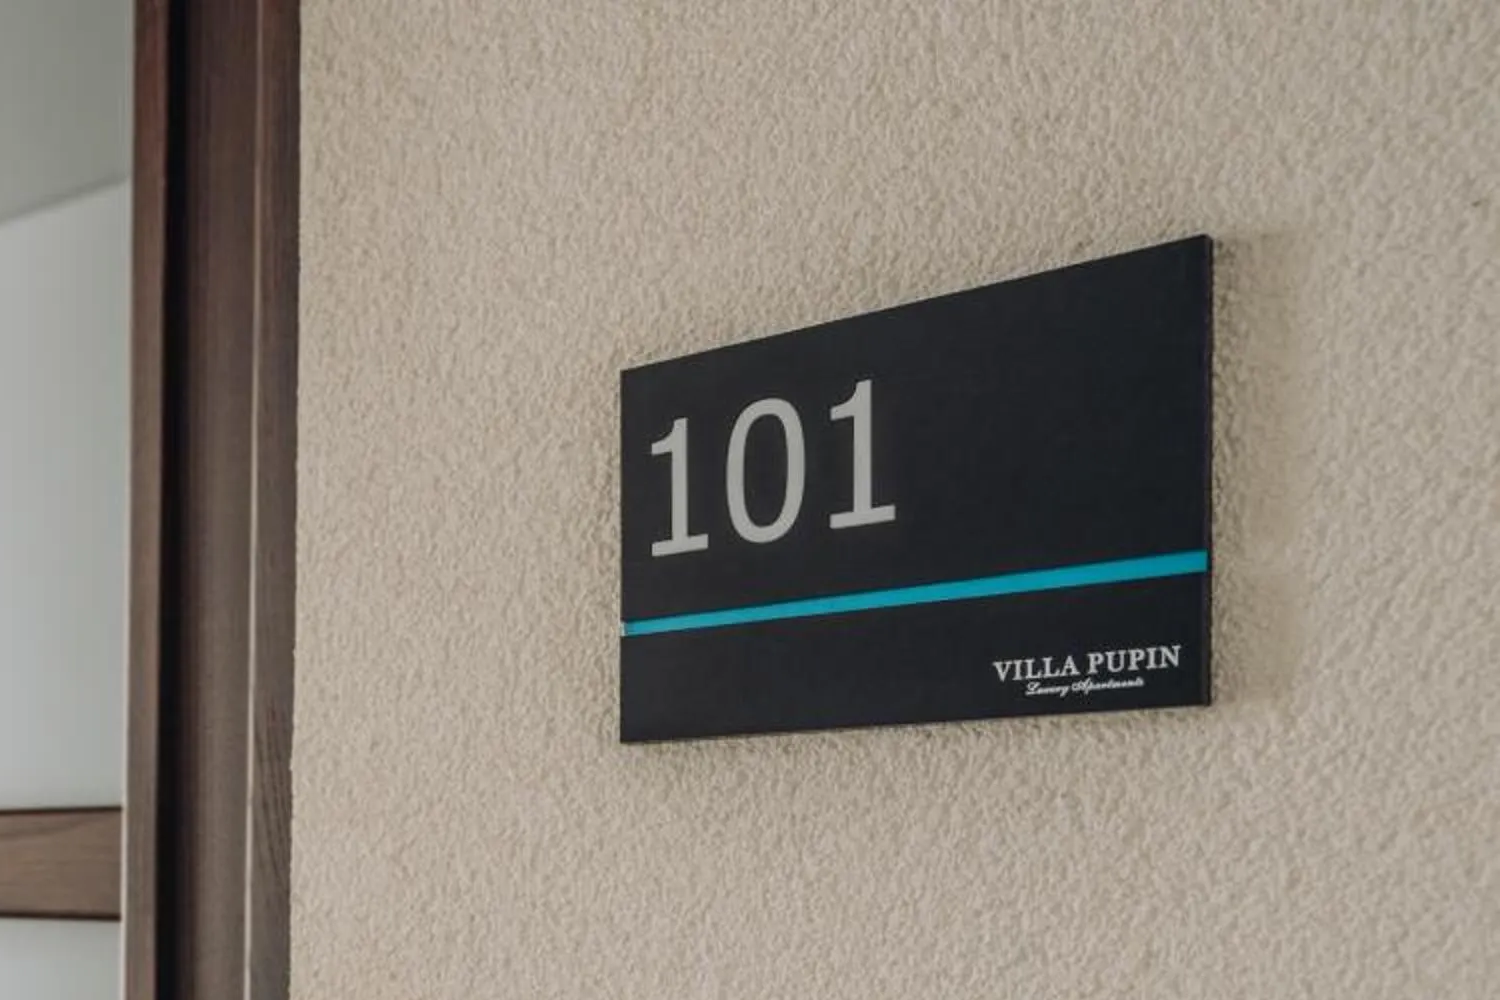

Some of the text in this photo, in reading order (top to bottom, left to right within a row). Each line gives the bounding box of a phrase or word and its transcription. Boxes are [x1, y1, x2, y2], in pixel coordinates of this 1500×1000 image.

[650, 379, 896, 557] 101
[992, 644, 1182, 683] VILLA PUPIN
